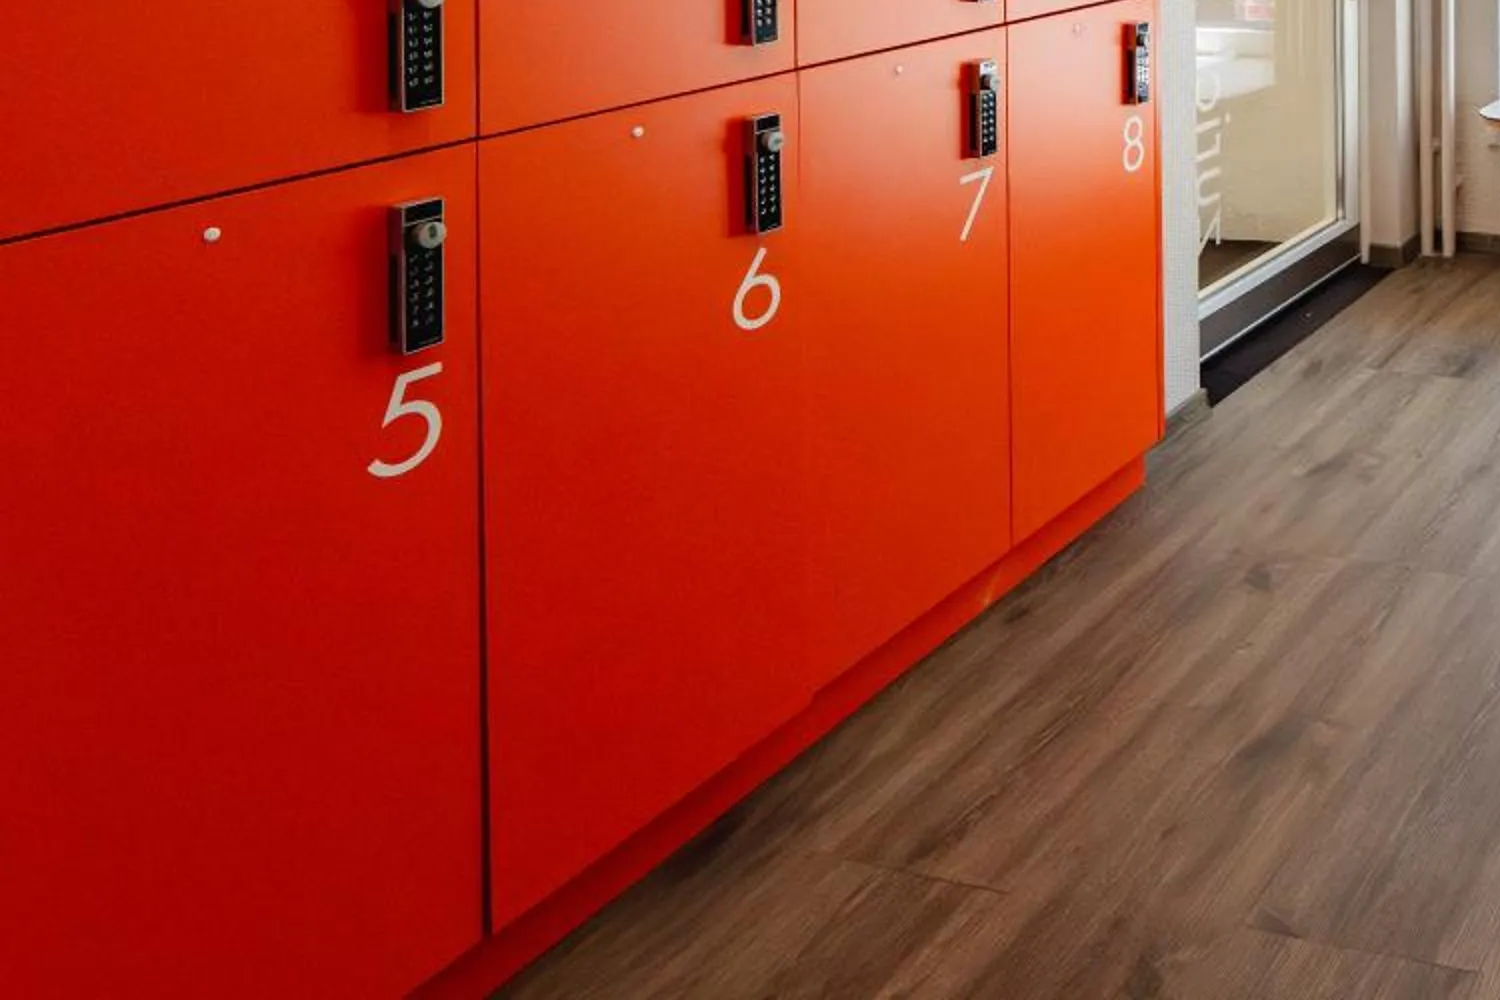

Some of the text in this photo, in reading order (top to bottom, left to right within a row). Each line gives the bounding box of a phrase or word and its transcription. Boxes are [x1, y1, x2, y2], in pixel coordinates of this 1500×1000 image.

[1122, 115, 1145, 173] 8
[959, 166, 995, 242] 7
[732, 247, 782, 331] 6
[367, 361, 443, 478] 5
